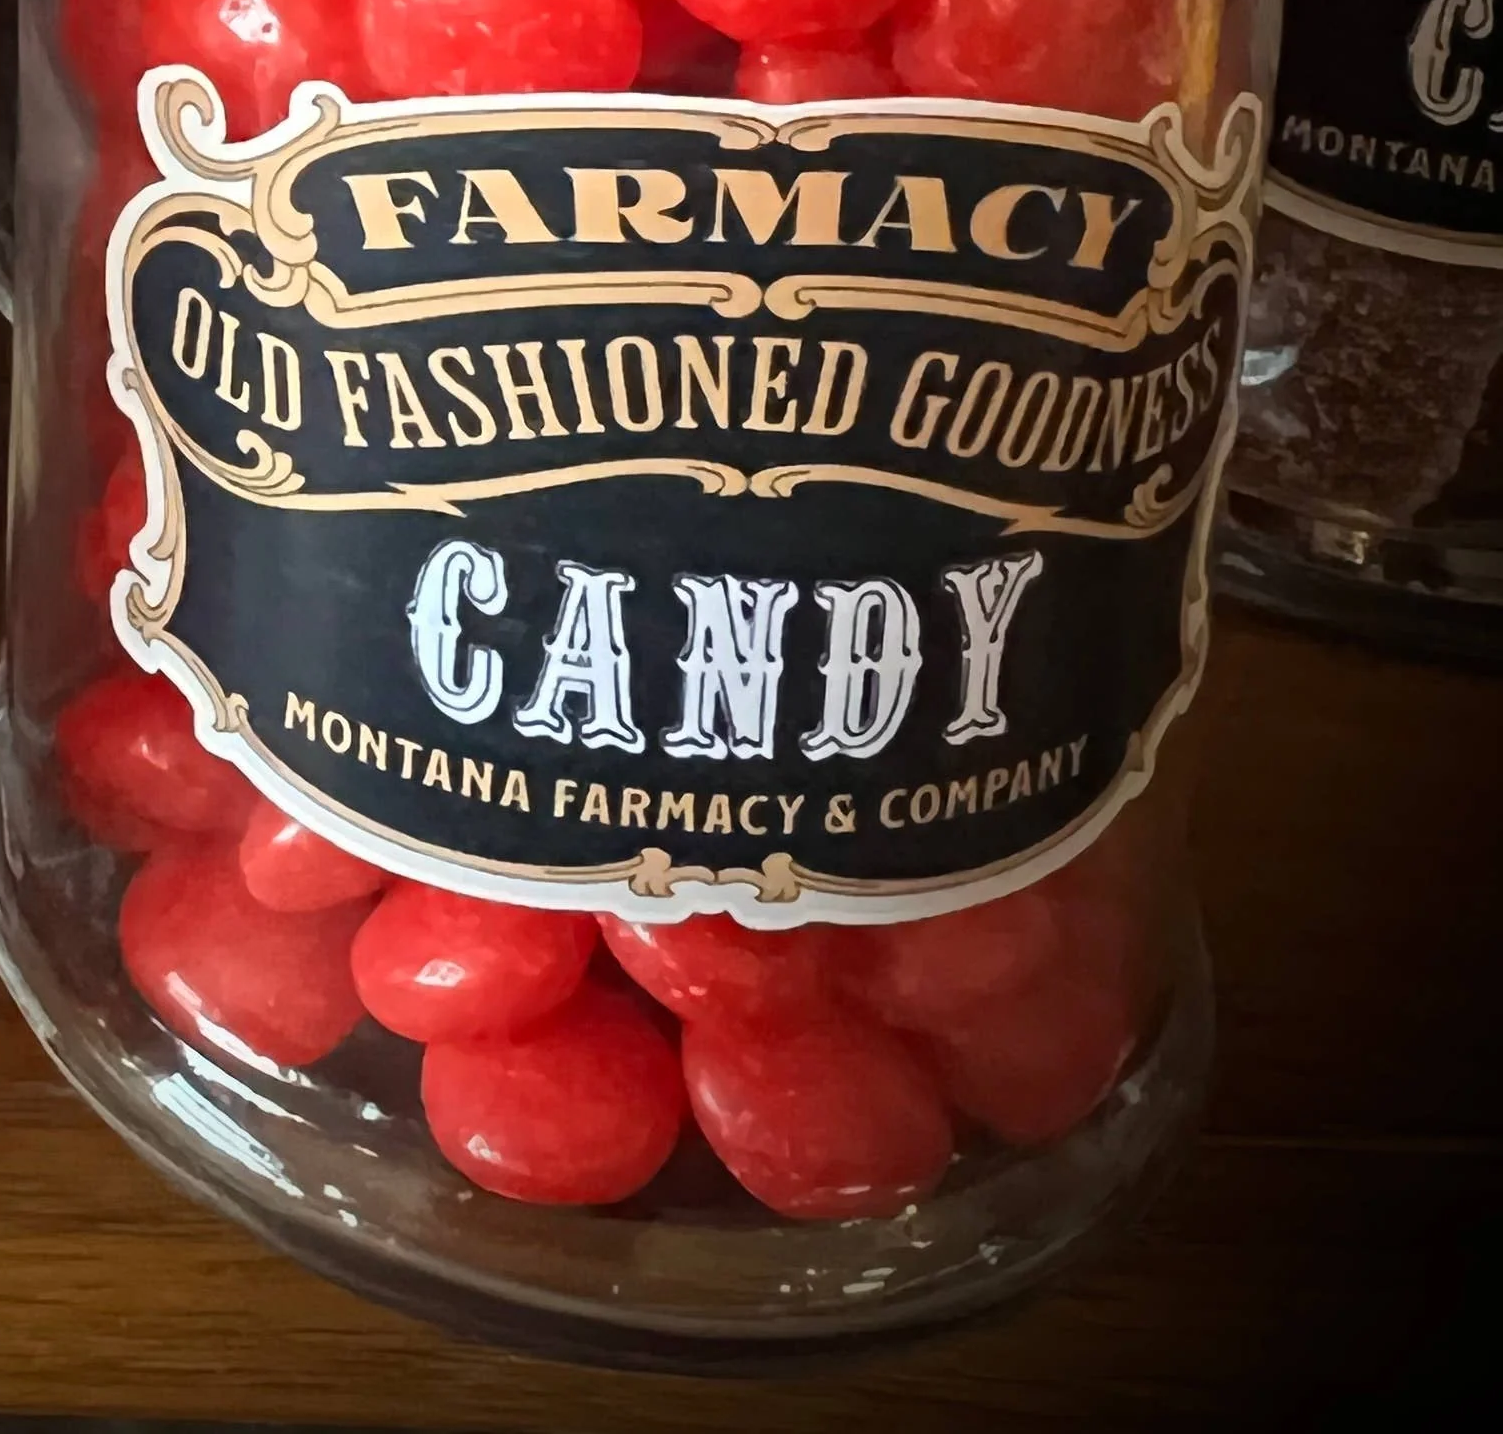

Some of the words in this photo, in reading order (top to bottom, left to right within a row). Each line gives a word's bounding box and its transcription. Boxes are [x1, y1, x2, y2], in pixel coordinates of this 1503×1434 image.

[342, 167, 1142, 271] FARMACY
[1281, 114, 1496, 194] MONTANA
[172, 286, 301, 432] OLD
[323, 334, 868, 450] FASHIONED
[889, 322, 1223, 474] GOODNESS
[405, 538, 1044, 762] CANDY
[284, 691, 532, 814] MONTANA
[553, 779, 805, 836] FARMACY
[824, 792, 858, 834] &
[879, 733, 1088, 828] COMPANY
